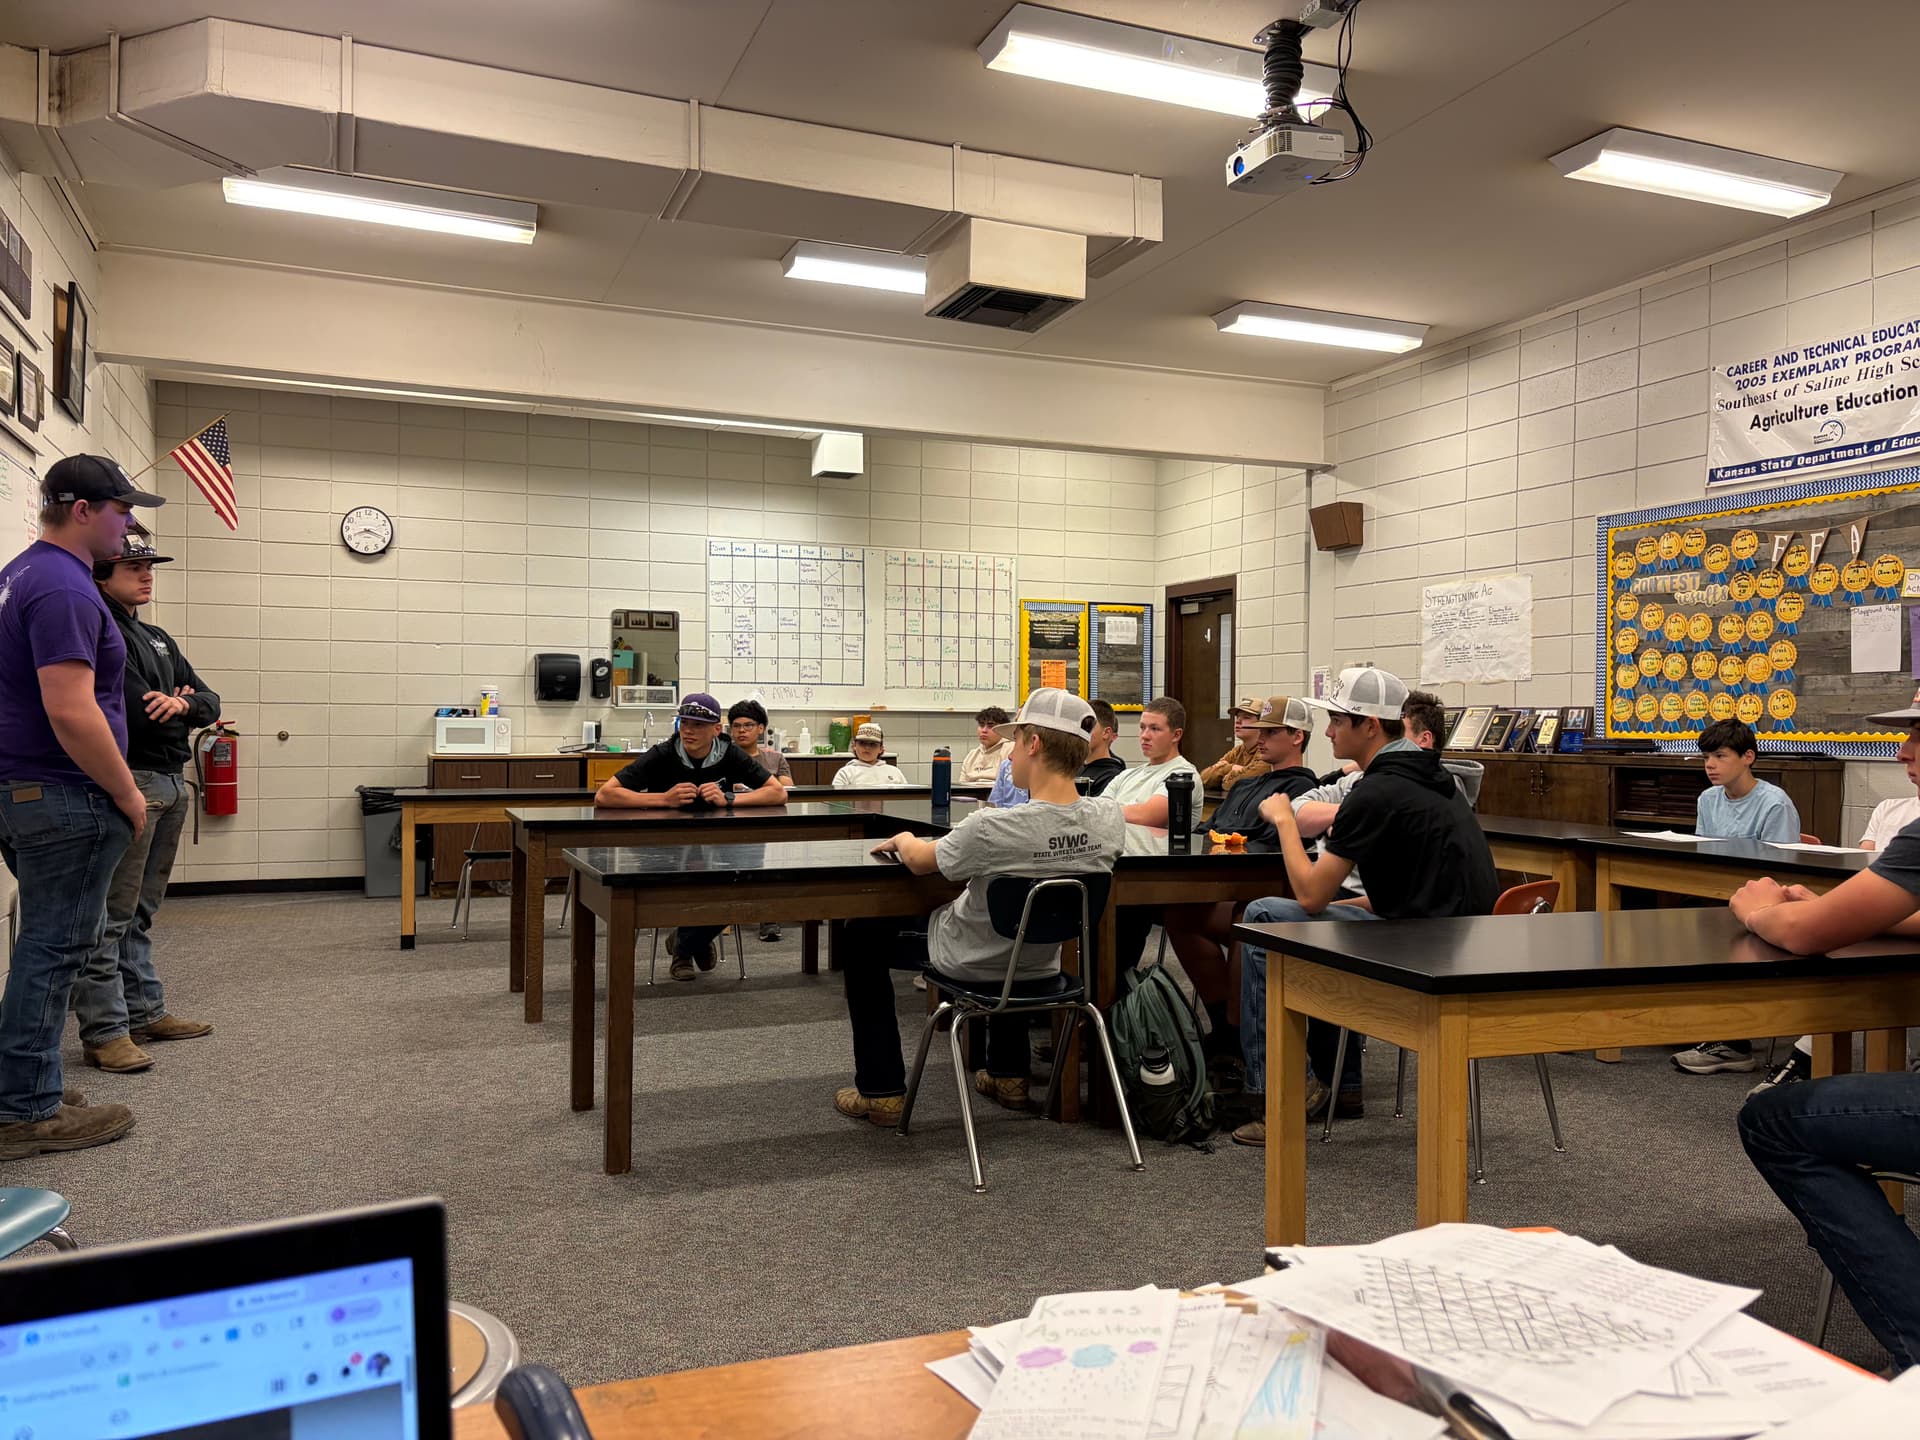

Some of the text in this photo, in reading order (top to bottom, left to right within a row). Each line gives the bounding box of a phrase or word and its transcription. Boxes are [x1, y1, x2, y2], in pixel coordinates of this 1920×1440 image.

[1726, 359, 1768, 378] CAREER
[1773, 352, 1798, 368] AND
[1803, 334, 1867, 361] TECHNICAL
[1735, 375, 1766, 390] 2005
[1773, 356, 1848, 384] EXEMPLARY
[1717, 389, 1778, 412] Southeast
[1784, 384, 1800, 398] of
[1804, 374, 1850, 394] Saline
[1857, 361, 1893, 380] High
[1750, 384, 1918, 432] Agriculture Education
[1716, 465, 1756, 479] Kansas
[1761, 458, 1793, 471] State
[1797, 444, 1868, 466] Department
[1874, 442, 1886, 451] of
[1631, 574, 1700, 594] CONTEST
[1048, 833, 1088, 850] SVWC
[1053, 846, 1087, 857] WRESTLING
[1037, 1298, 1143, 1320] Kansas
